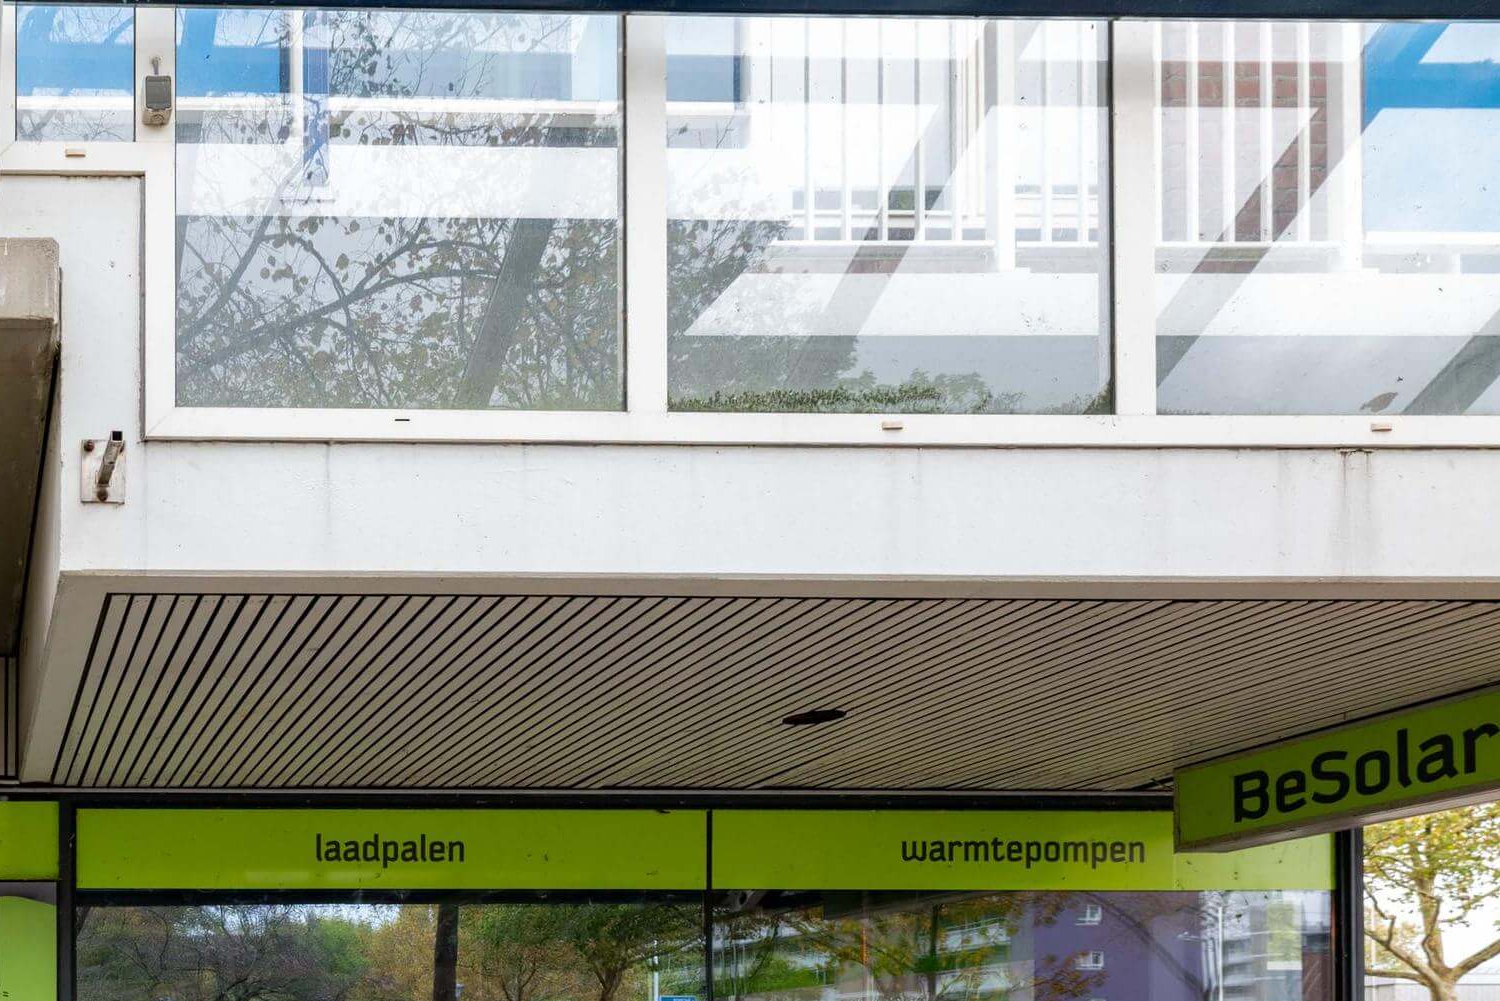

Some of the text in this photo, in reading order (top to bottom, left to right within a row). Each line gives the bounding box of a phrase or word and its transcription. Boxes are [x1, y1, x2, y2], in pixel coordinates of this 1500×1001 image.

[1232, 722, 1500, 824] BeSolar
[315, 832, 466, 869] laadpalen
[900, 836, 1146, 870] warmtepompen
